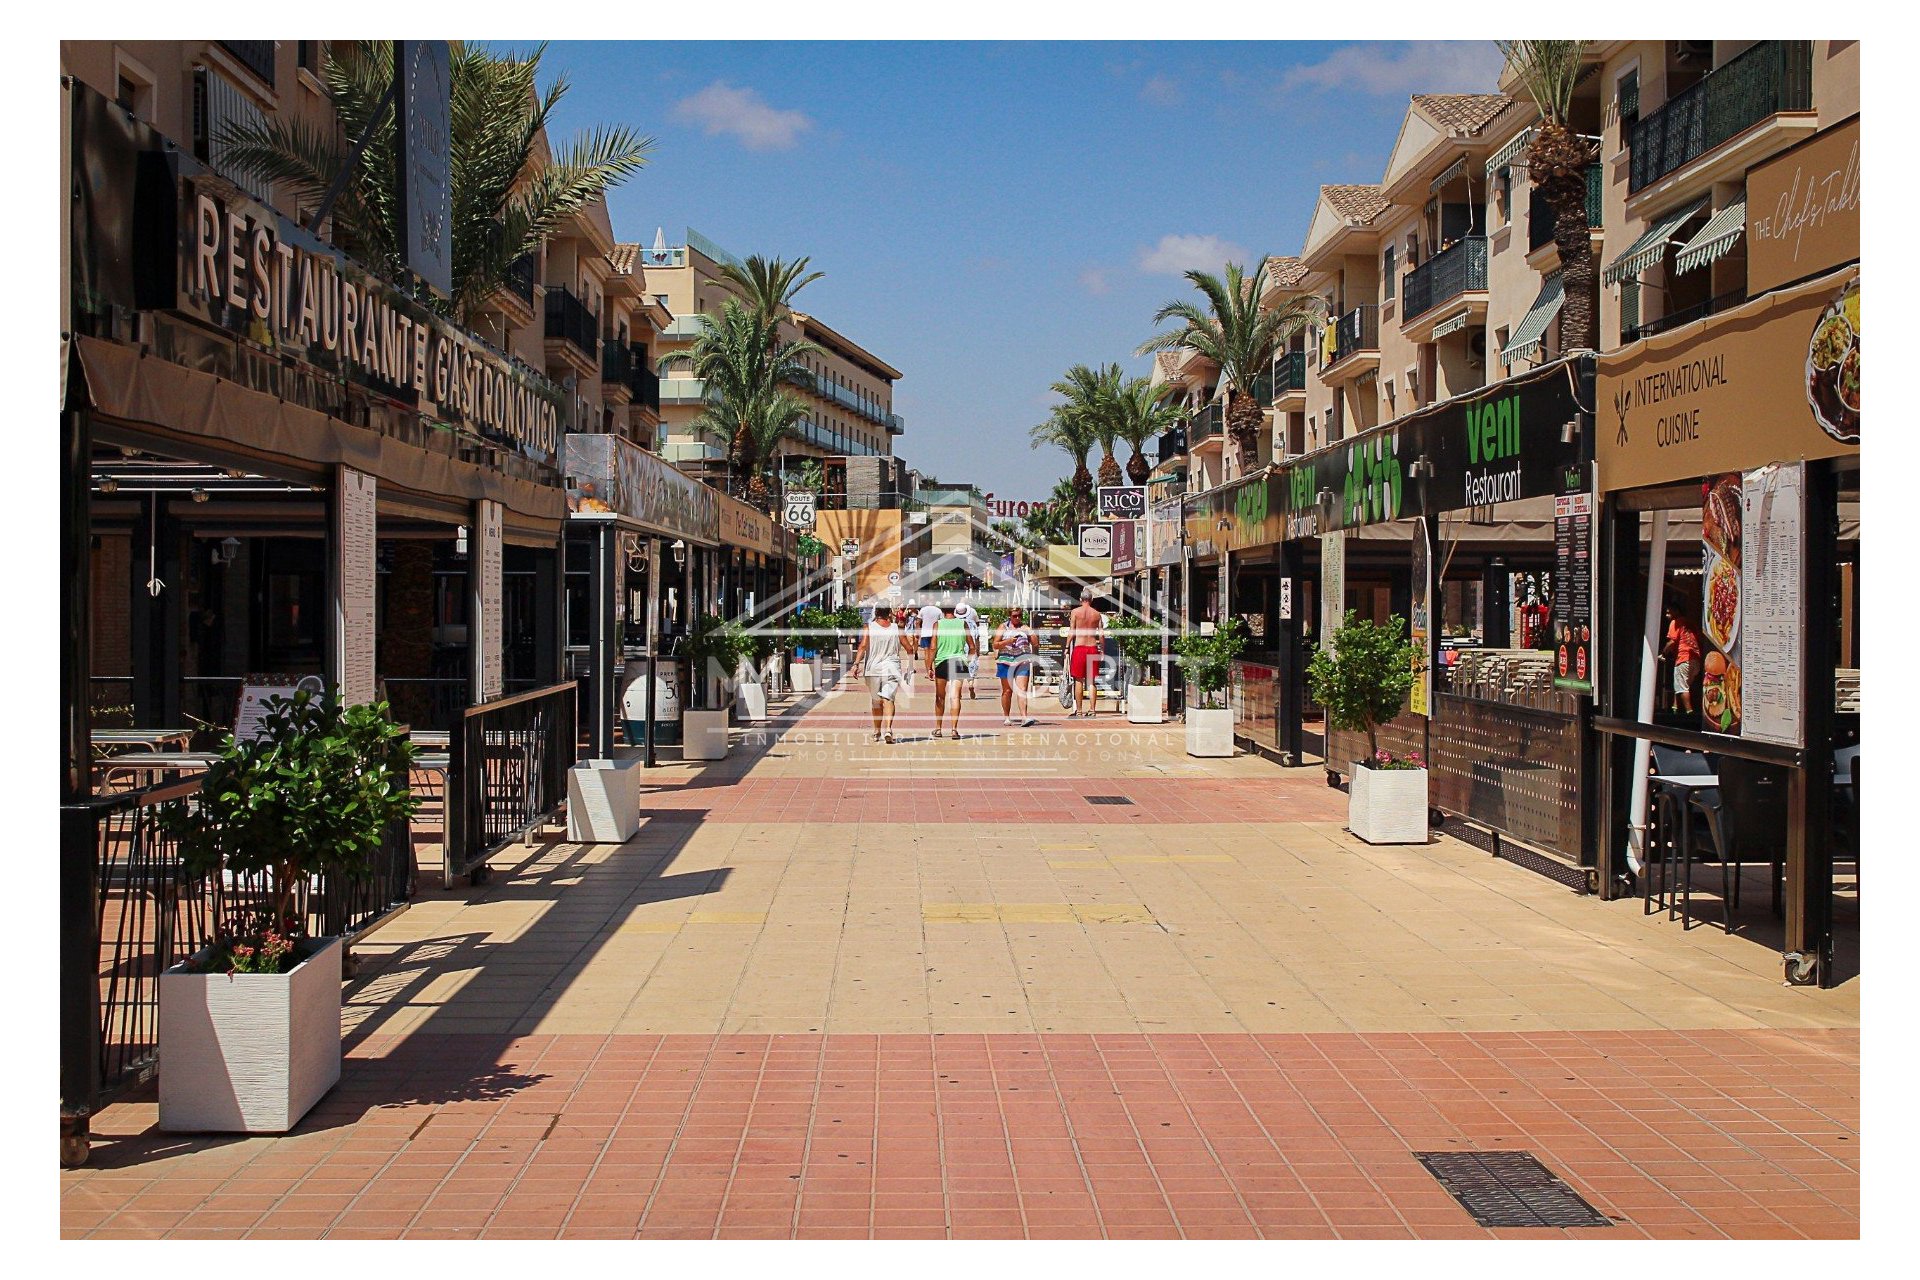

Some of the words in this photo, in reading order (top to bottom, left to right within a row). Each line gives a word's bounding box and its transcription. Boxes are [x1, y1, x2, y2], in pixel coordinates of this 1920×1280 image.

[1754, 216, 1770, 241] THE
[1773, 166, 1822, 263] Chef's
[1820, 139, 1861, 228] Tabl
[197, 194, 429, 393] RESTAURANTE
[1634, 353, 1727, 408] INTERNATIONAL
[1656, 408, 1700, 448] CUISINE
[1465, 460, 1522, 507] Restaurant
[788, 504, 812, 522] 66
